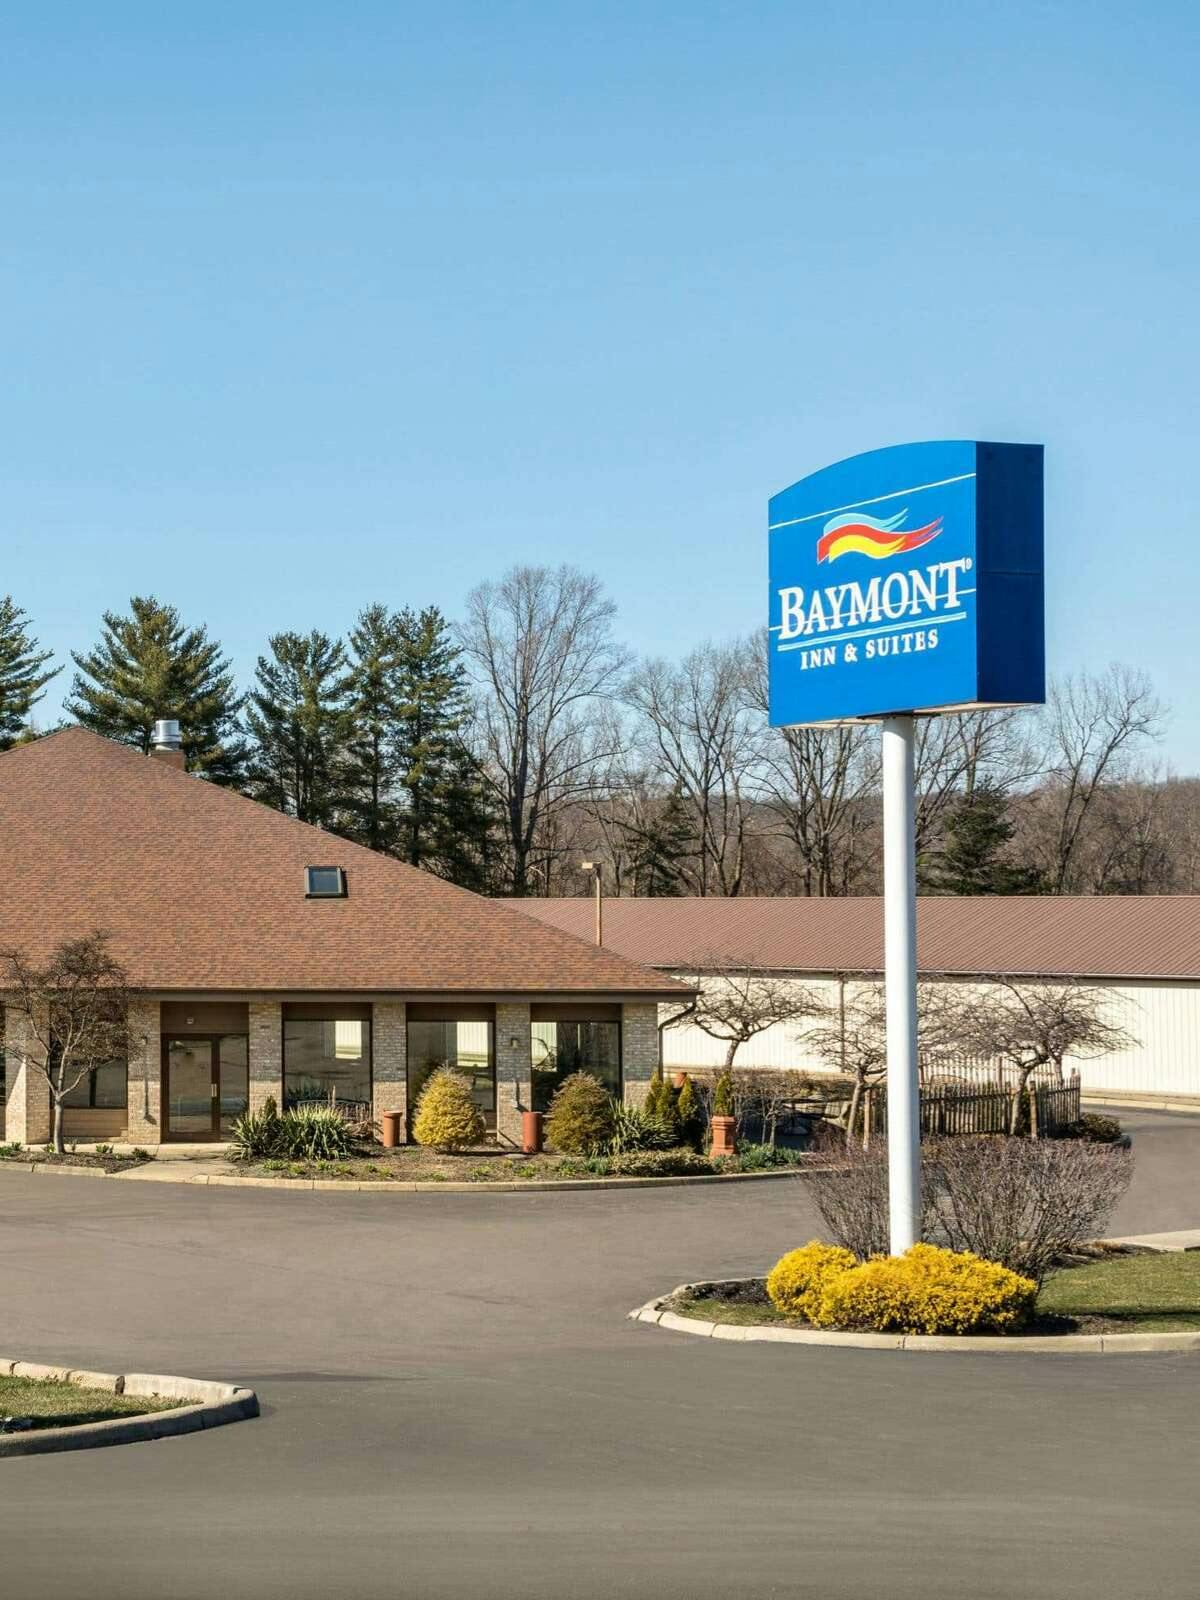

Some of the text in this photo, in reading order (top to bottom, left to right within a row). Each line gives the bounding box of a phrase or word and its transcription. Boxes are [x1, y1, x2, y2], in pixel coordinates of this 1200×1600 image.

[778, 559, 966, 640] BAYMONT
[800, 629, 939, 670] INN & SUITES
